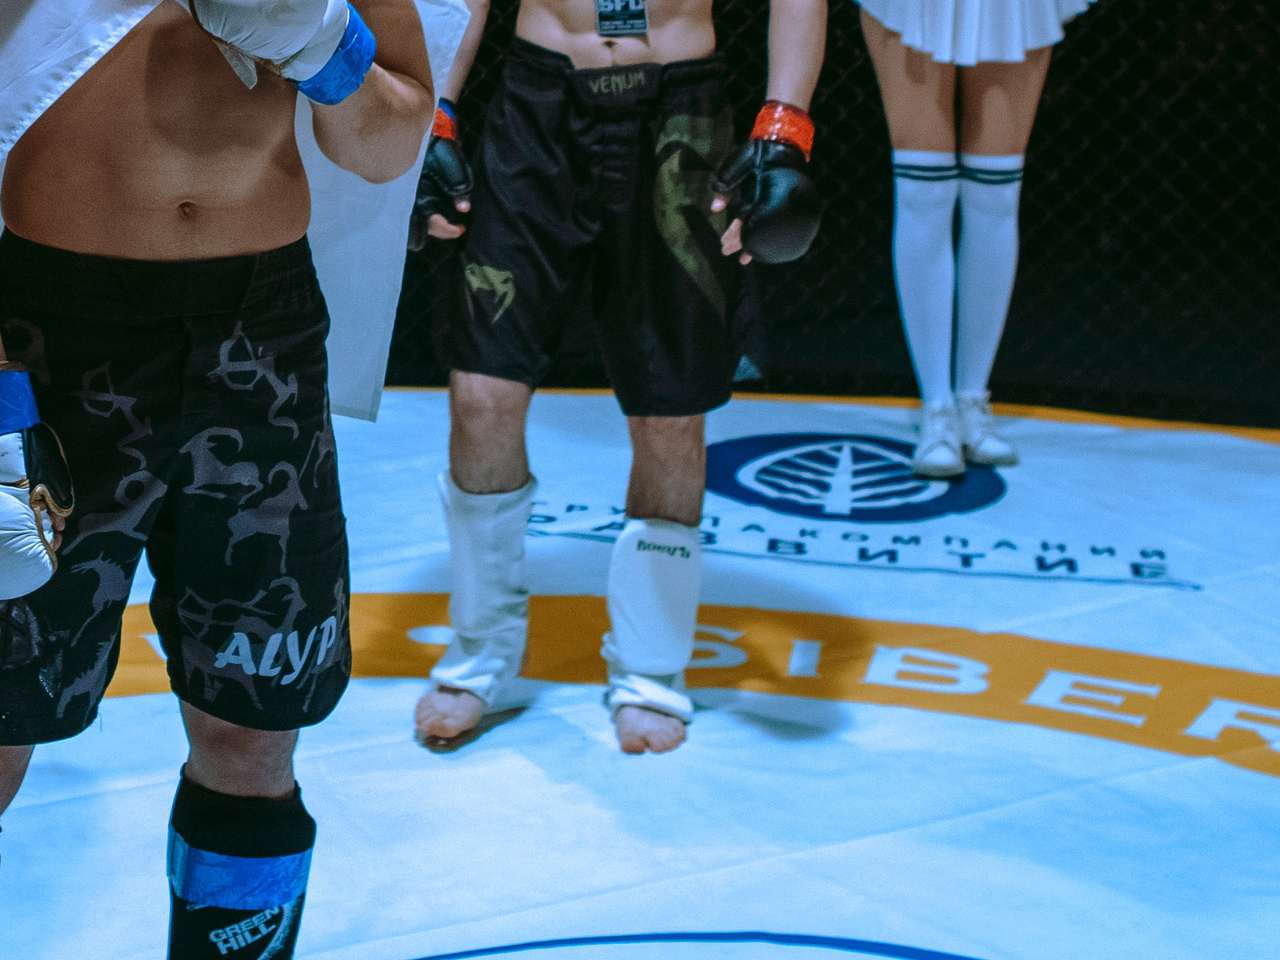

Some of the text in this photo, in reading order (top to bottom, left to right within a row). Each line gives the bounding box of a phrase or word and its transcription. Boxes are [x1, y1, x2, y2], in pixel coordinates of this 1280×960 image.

[588, 71, 645, 95] VENUM
[209, 905, 281, 943] GREEN
[216, 923, 277, 955] HILL
